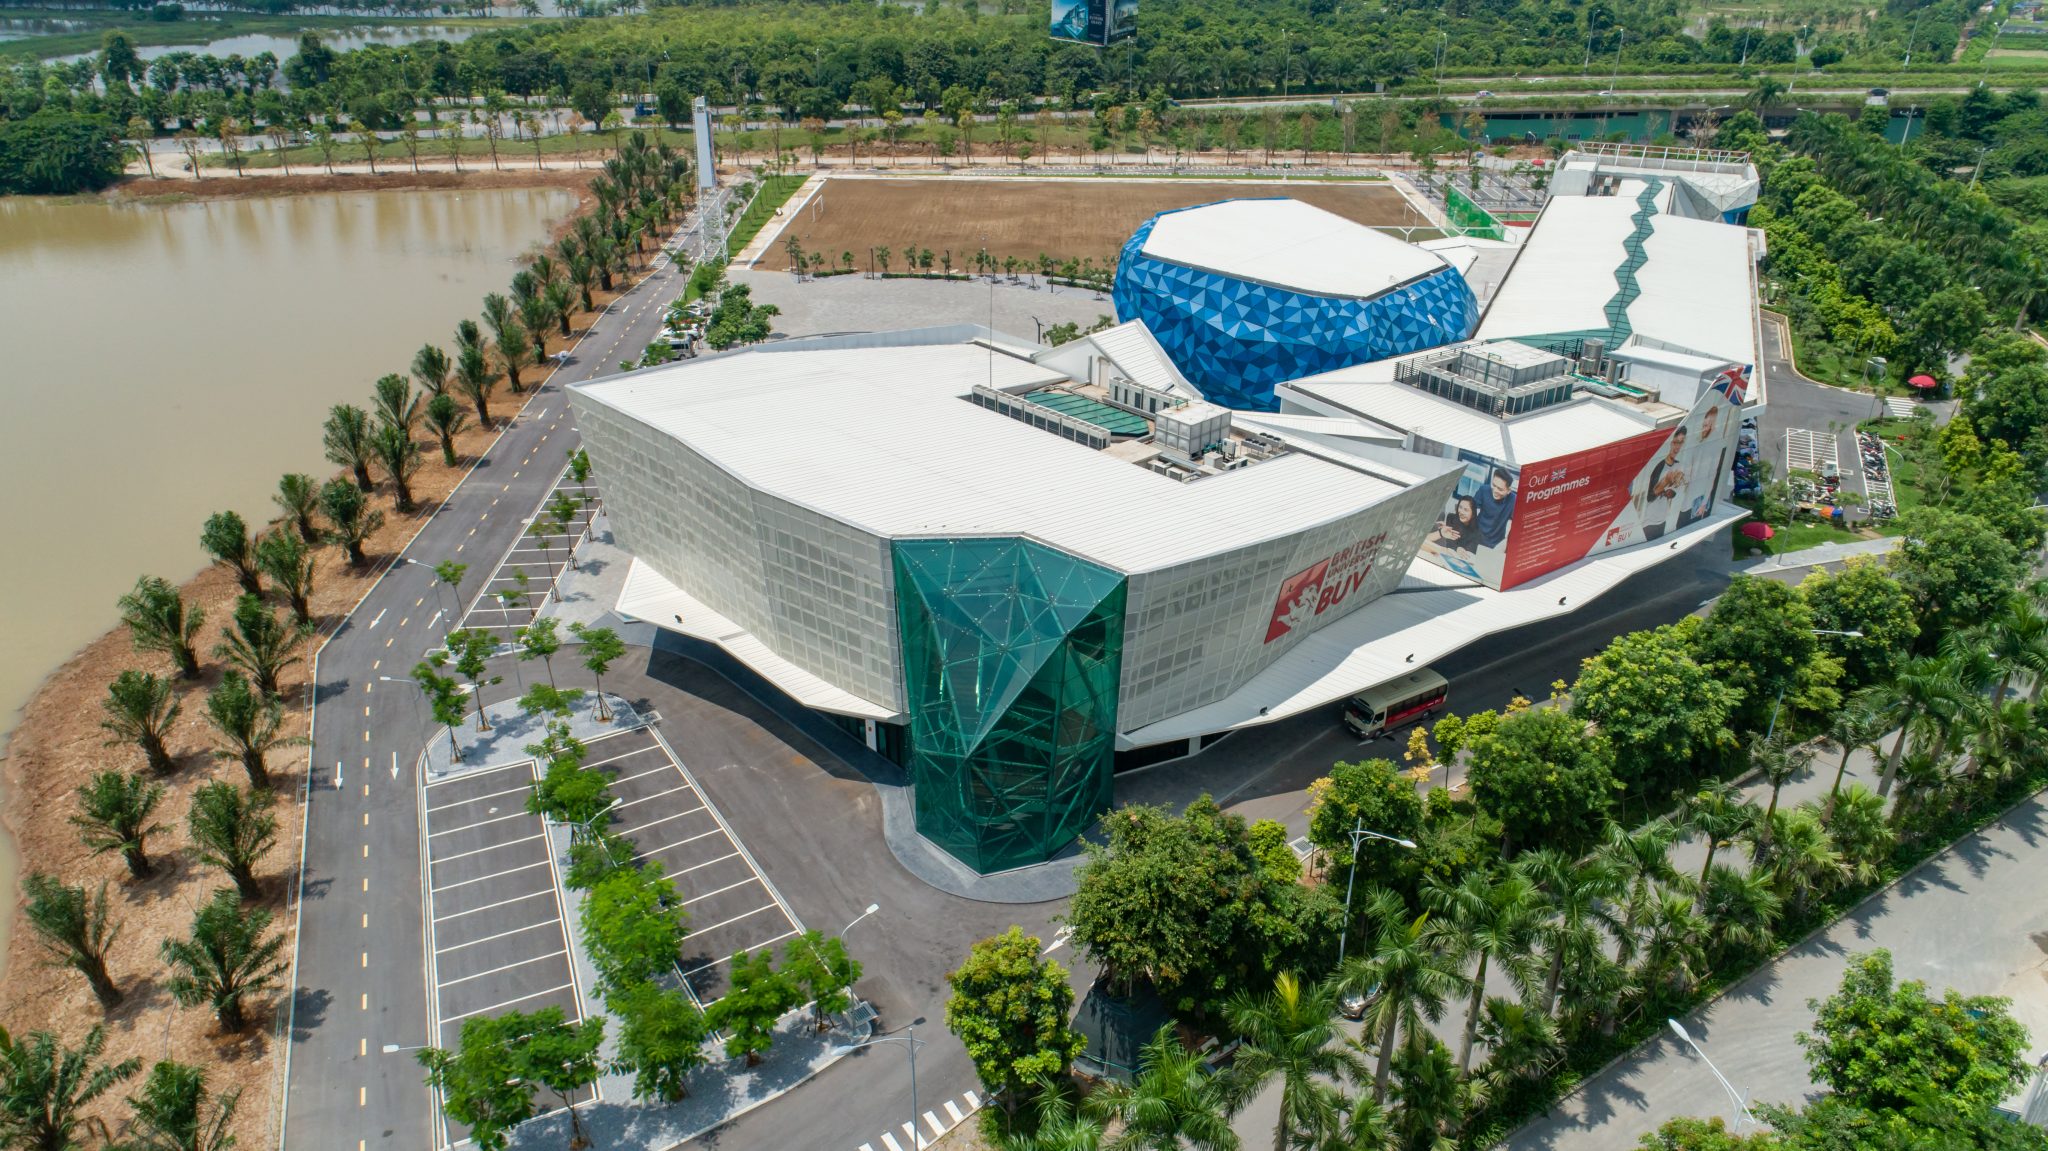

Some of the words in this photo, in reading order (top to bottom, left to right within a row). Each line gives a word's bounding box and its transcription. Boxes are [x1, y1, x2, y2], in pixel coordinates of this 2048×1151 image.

[1526, 476, 1590, 503] Programmes
[1528, 474, 1548, 488] Our
[1327, 547, 1379, 579] UNIVERSITY
[1331, 531, 1387, 567] BRITISH
[1314, 564, 1372, 616] BUV
